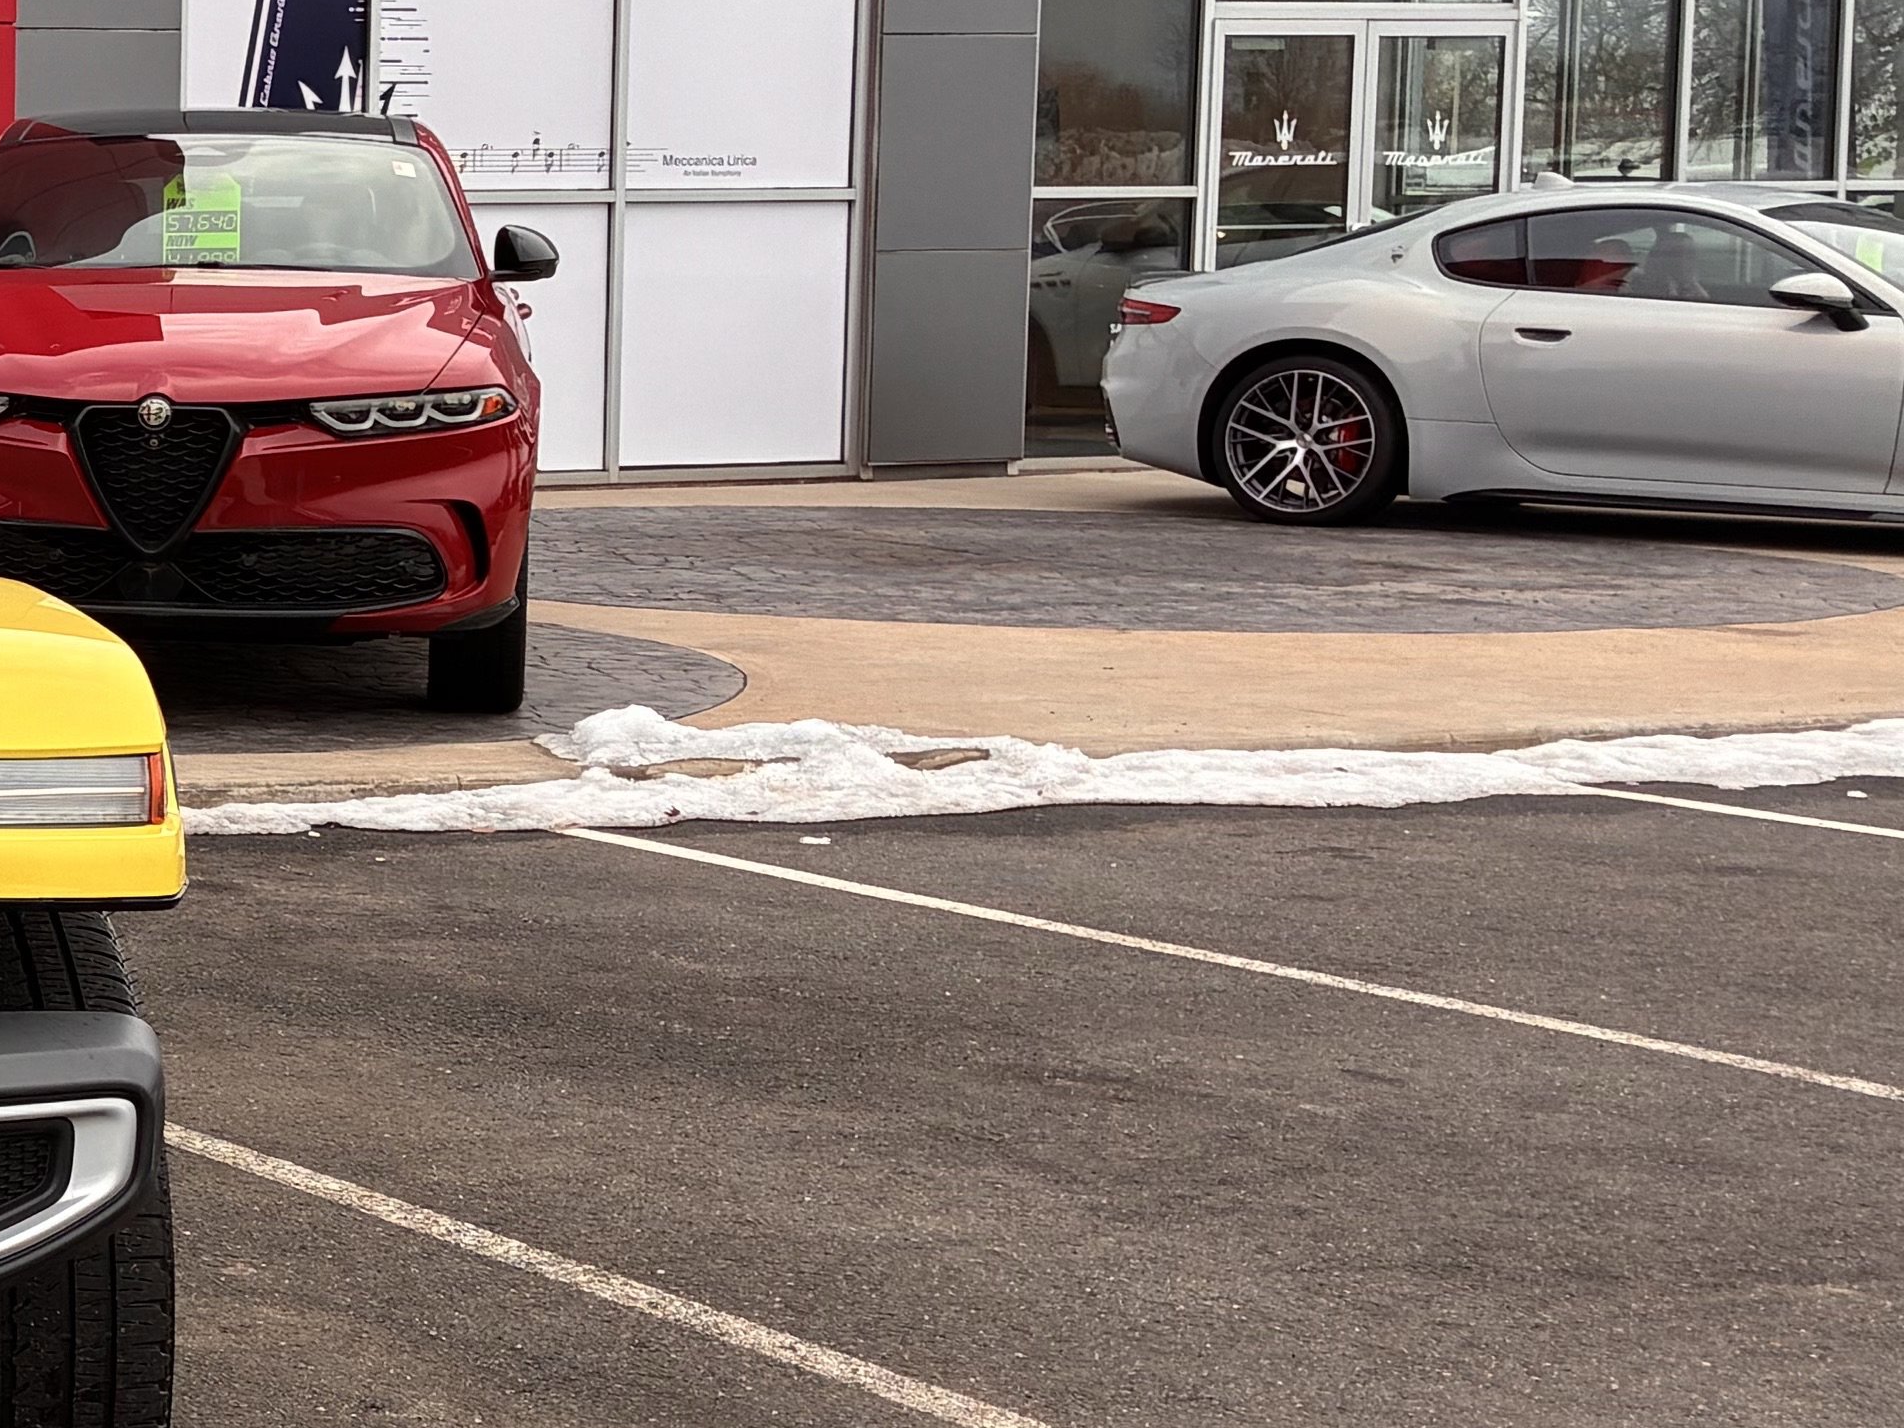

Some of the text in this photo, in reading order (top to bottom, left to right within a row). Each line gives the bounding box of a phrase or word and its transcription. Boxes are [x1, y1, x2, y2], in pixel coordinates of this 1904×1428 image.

[1228, 150, 1337, 166] Maserati
[1383, 150, 1488, 167] Maserati
[168, 214, 237, 232] 57,640
